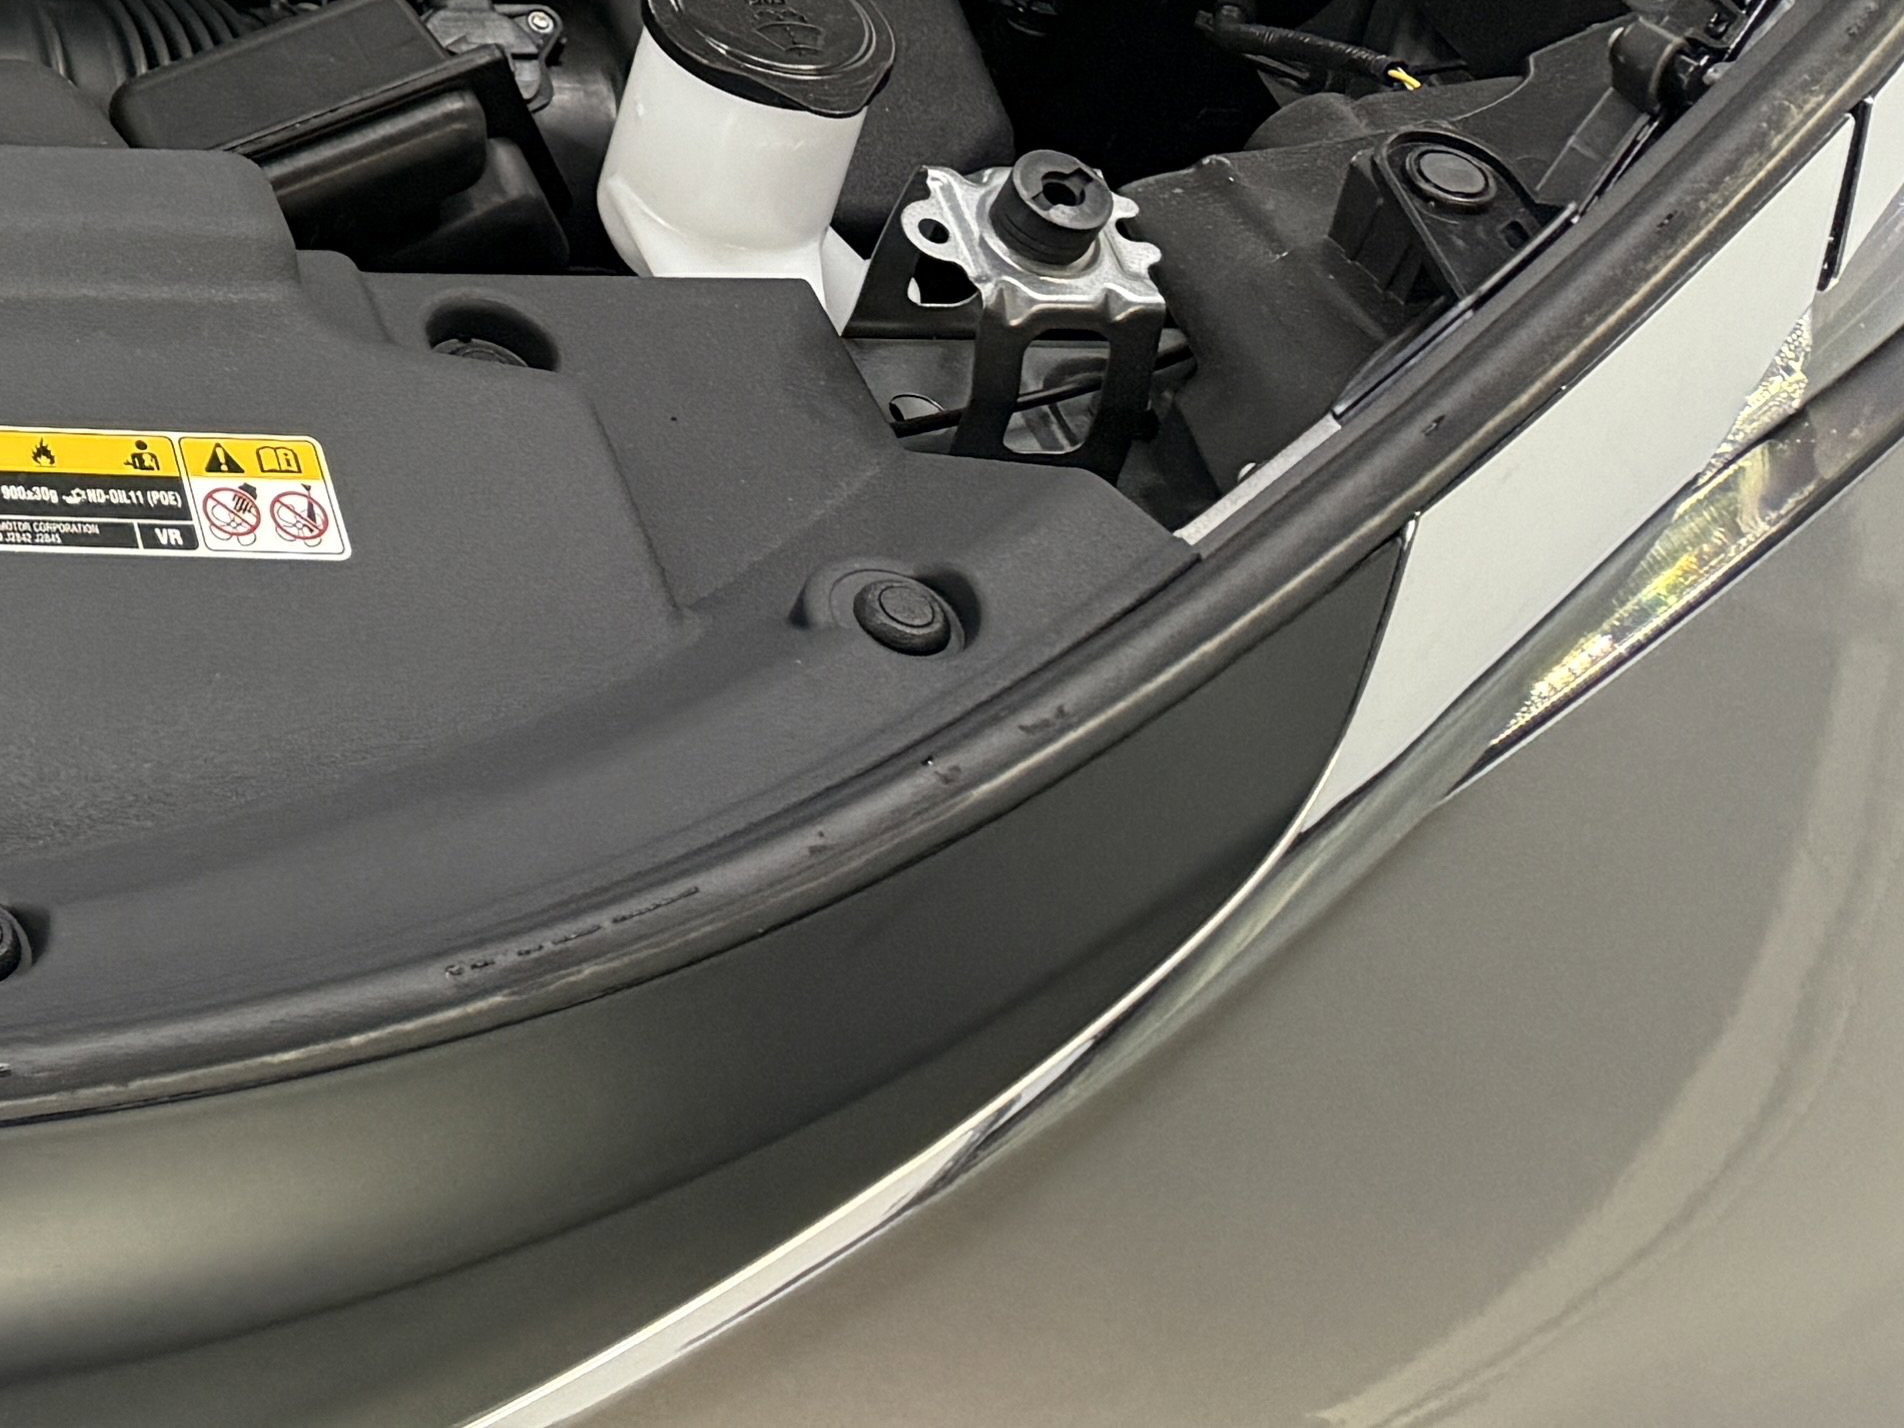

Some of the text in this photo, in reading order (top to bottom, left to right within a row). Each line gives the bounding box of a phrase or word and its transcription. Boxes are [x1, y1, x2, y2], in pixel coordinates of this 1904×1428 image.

[146, 490, 183, 508] (POE)
[32, 521, 101, 535] CORPORATION
[154, 527, 184, 546] VR
